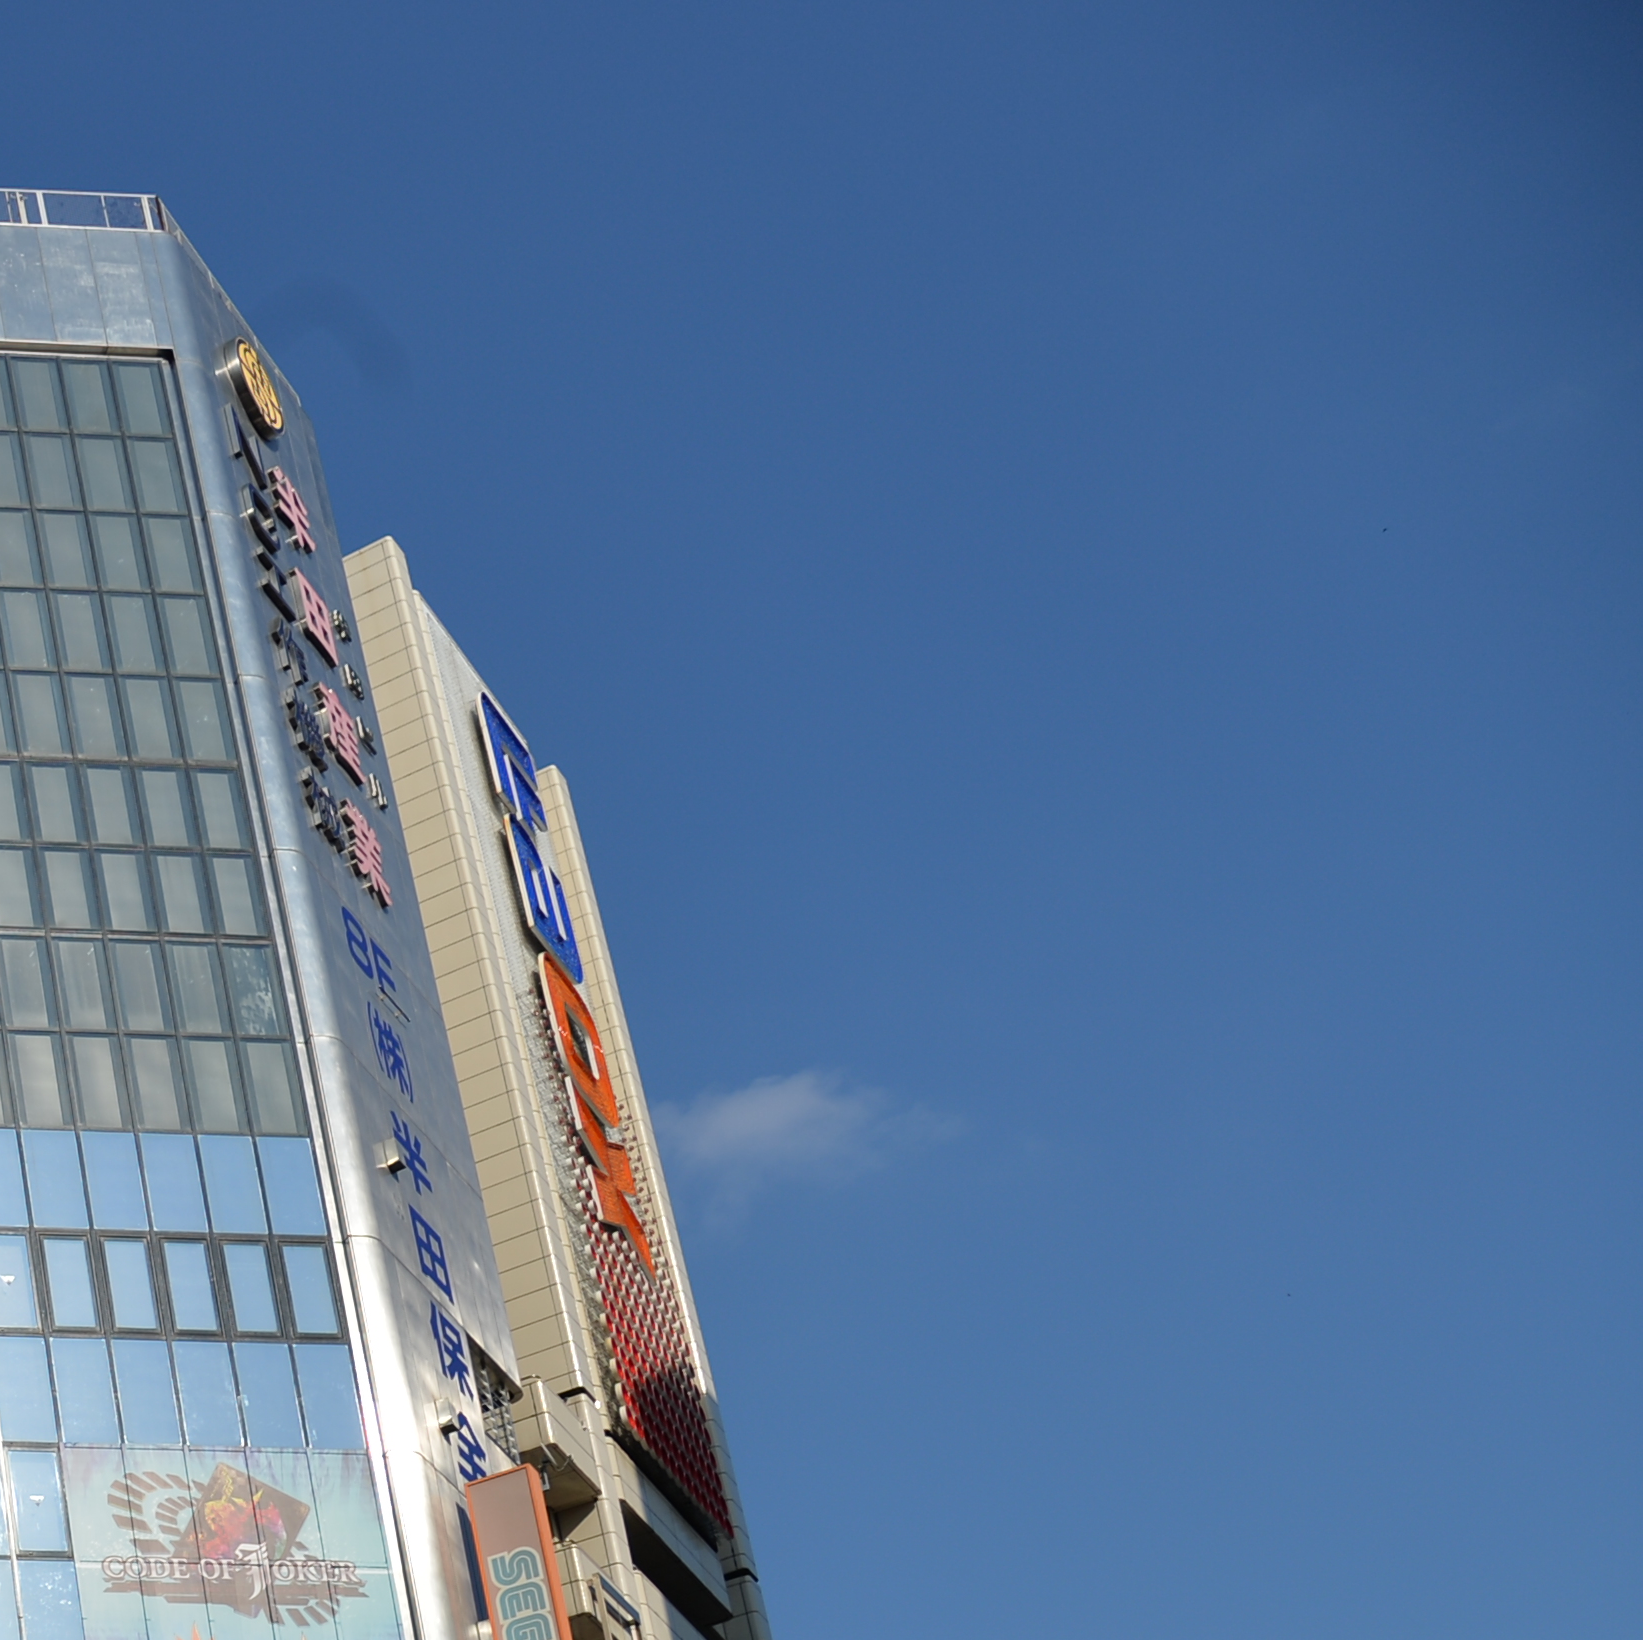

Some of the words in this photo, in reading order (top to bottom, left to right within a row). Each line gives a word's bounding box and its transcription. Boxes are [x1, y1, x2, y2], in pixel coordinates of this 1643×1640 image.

[341, 906, 397, 993] 8F
[102, 1555, 190, 1581] CODE
[199, 1556, 236, 1581] OF
[234, 1541, 362, 1601] JOKER
